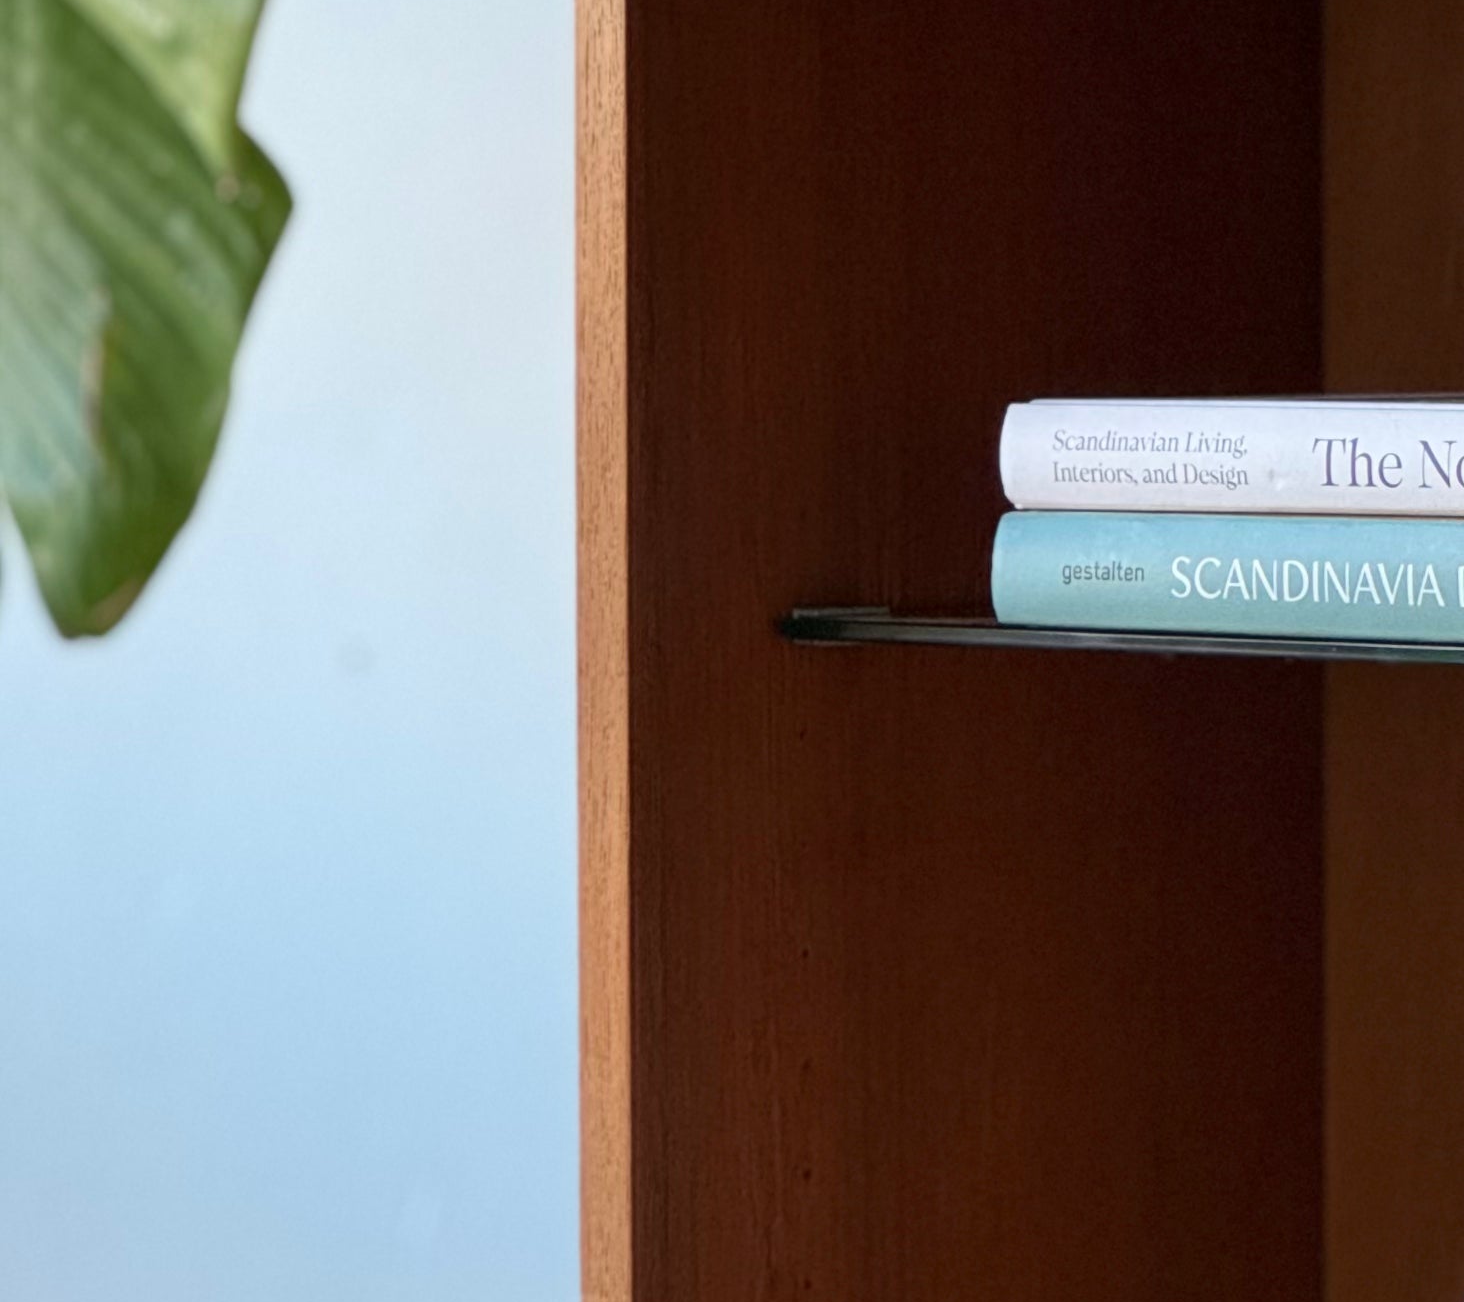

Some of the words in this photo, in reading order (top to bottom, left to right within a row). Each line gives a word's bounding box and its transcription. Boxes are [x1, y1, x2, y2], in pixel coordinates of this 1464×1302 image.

[1053, 429, 1179, 454] Scandinavian
[1053, 462, 1139, 486] Interiors,
[1142, 463, 1177, 485] and
[1183, 463, 1249, 491] Design
[1312, 437, 1404, 489] The
[1061, 560, 1145, 585] gestalten
[1170, 555, 1445, 608] SCANDINAVIA
